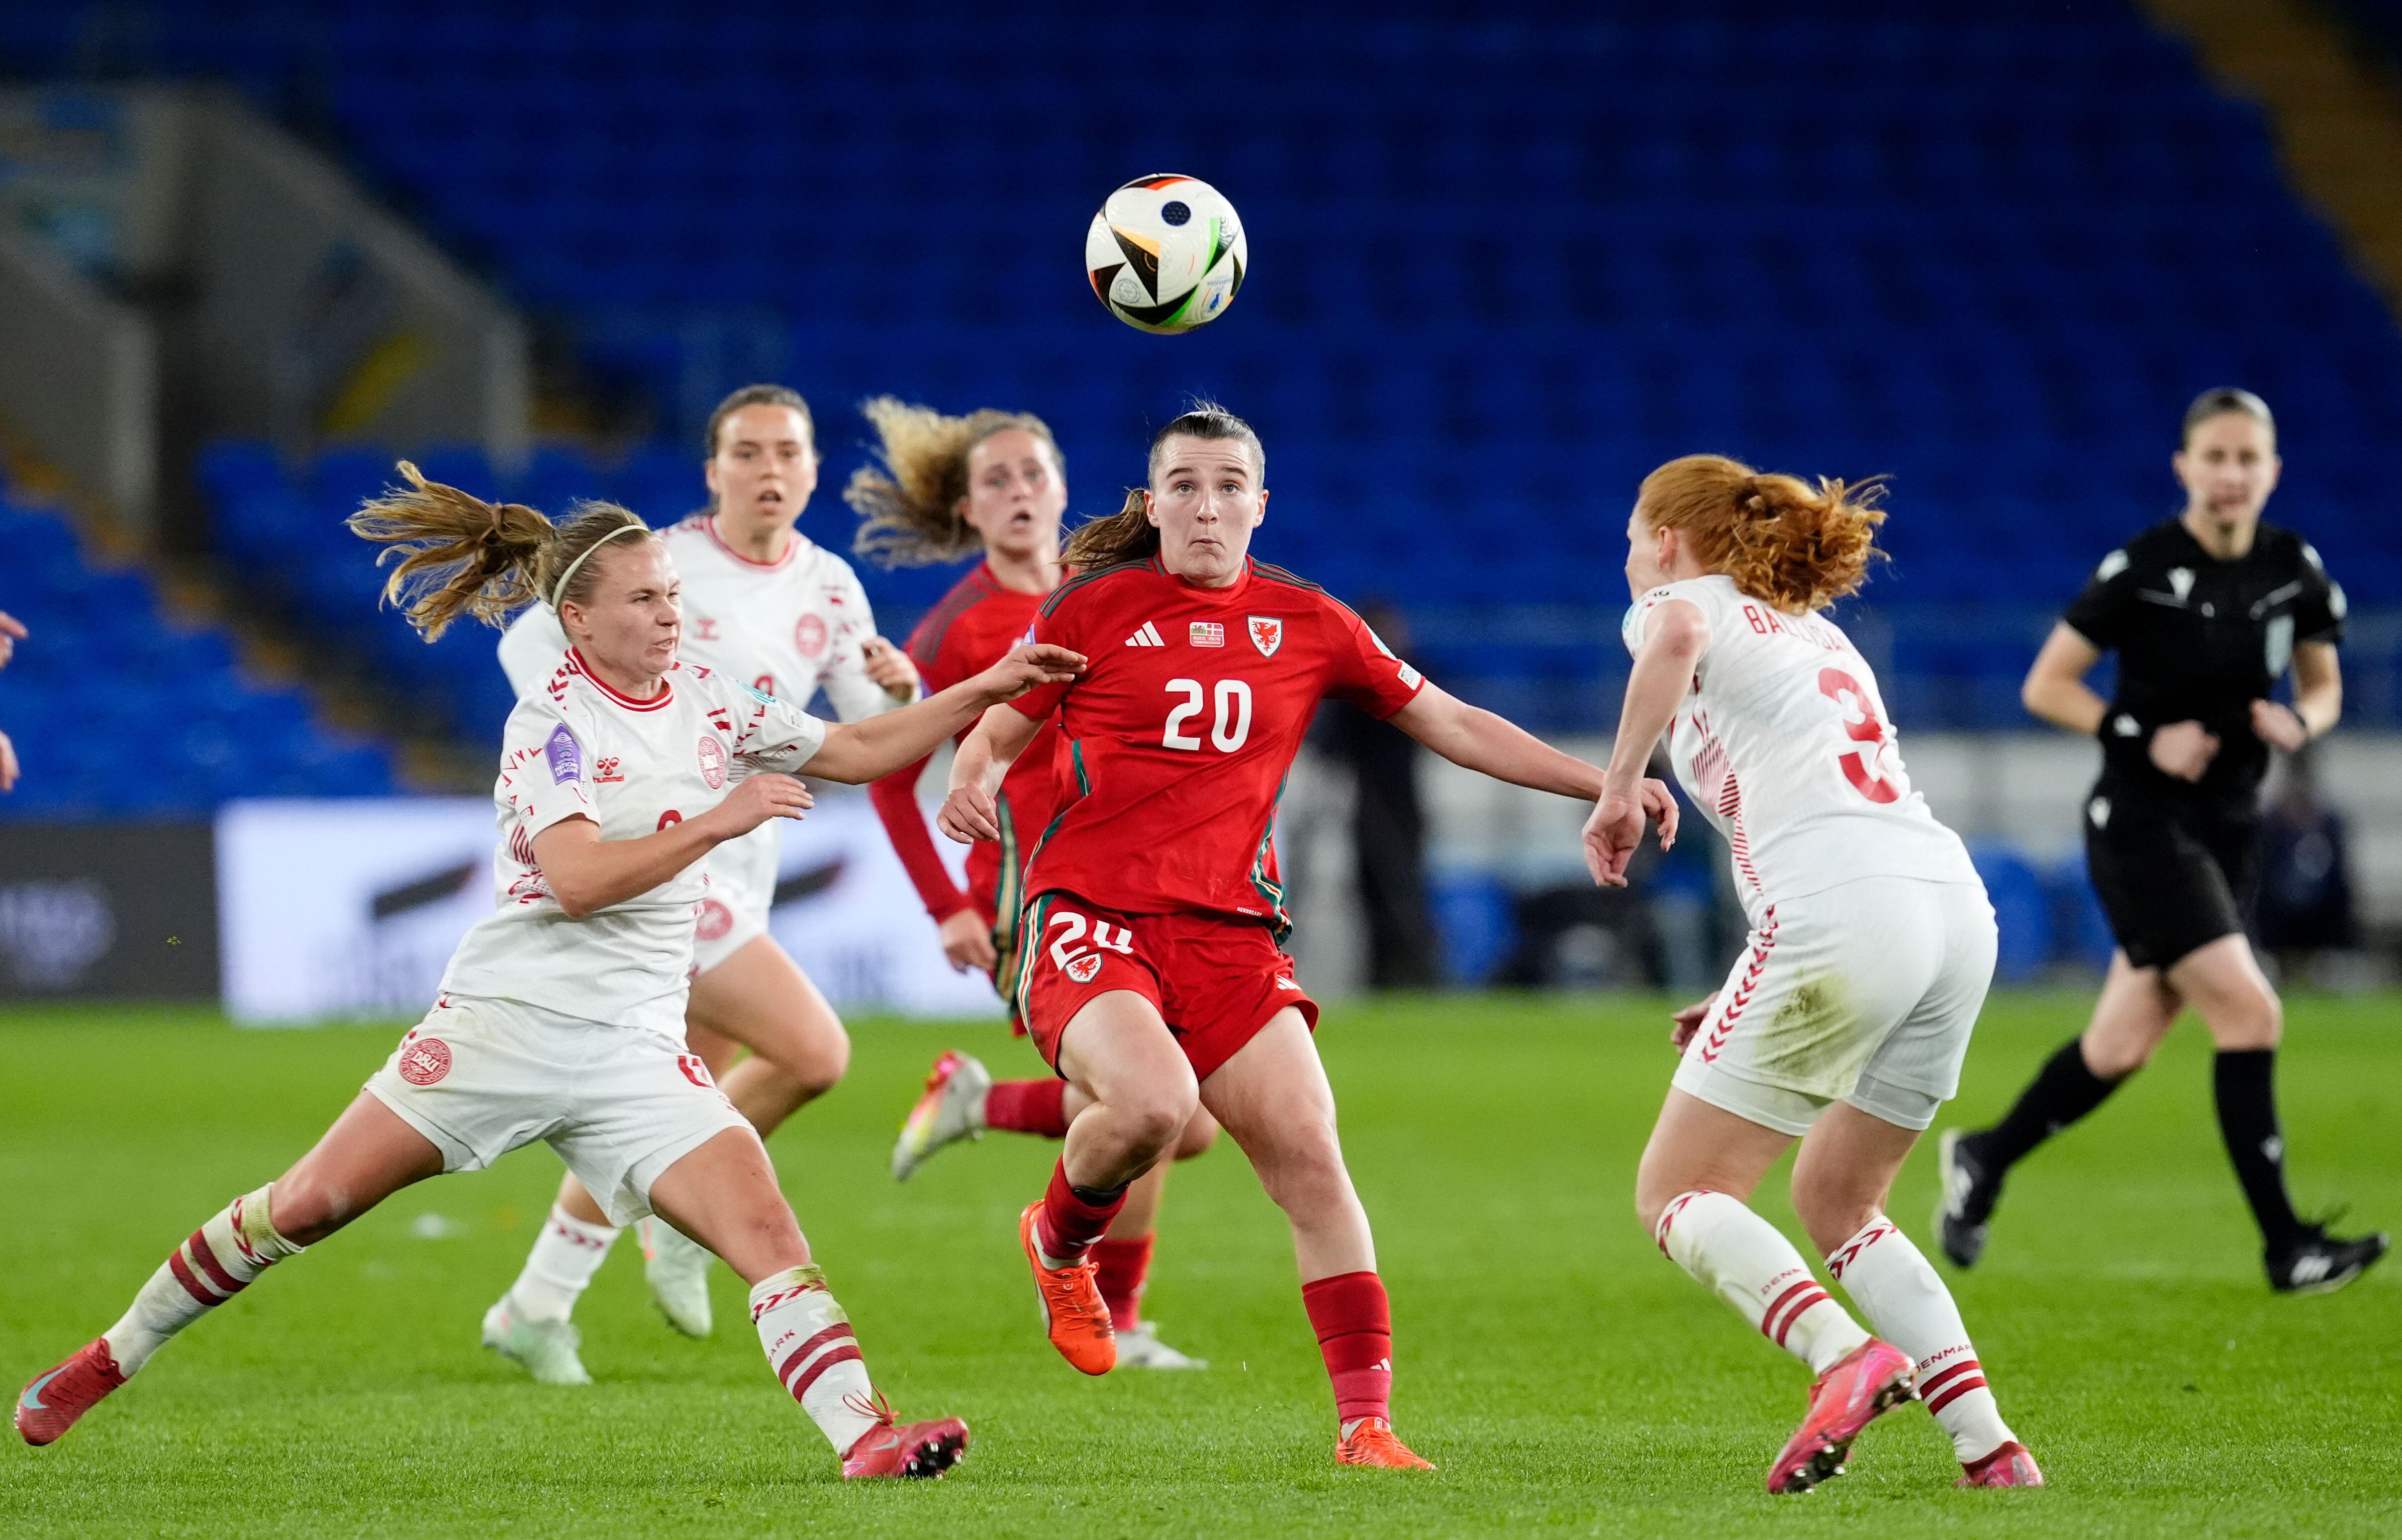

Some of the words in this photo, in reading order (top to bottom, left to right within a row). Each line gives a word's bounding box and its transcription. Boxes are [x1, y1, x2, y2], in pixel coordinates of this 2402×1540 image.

[1162, 678, 1252, 753] 20
[1819, 668, 1899, 804] 3
[410, 1051, 440, 1072] DBU
